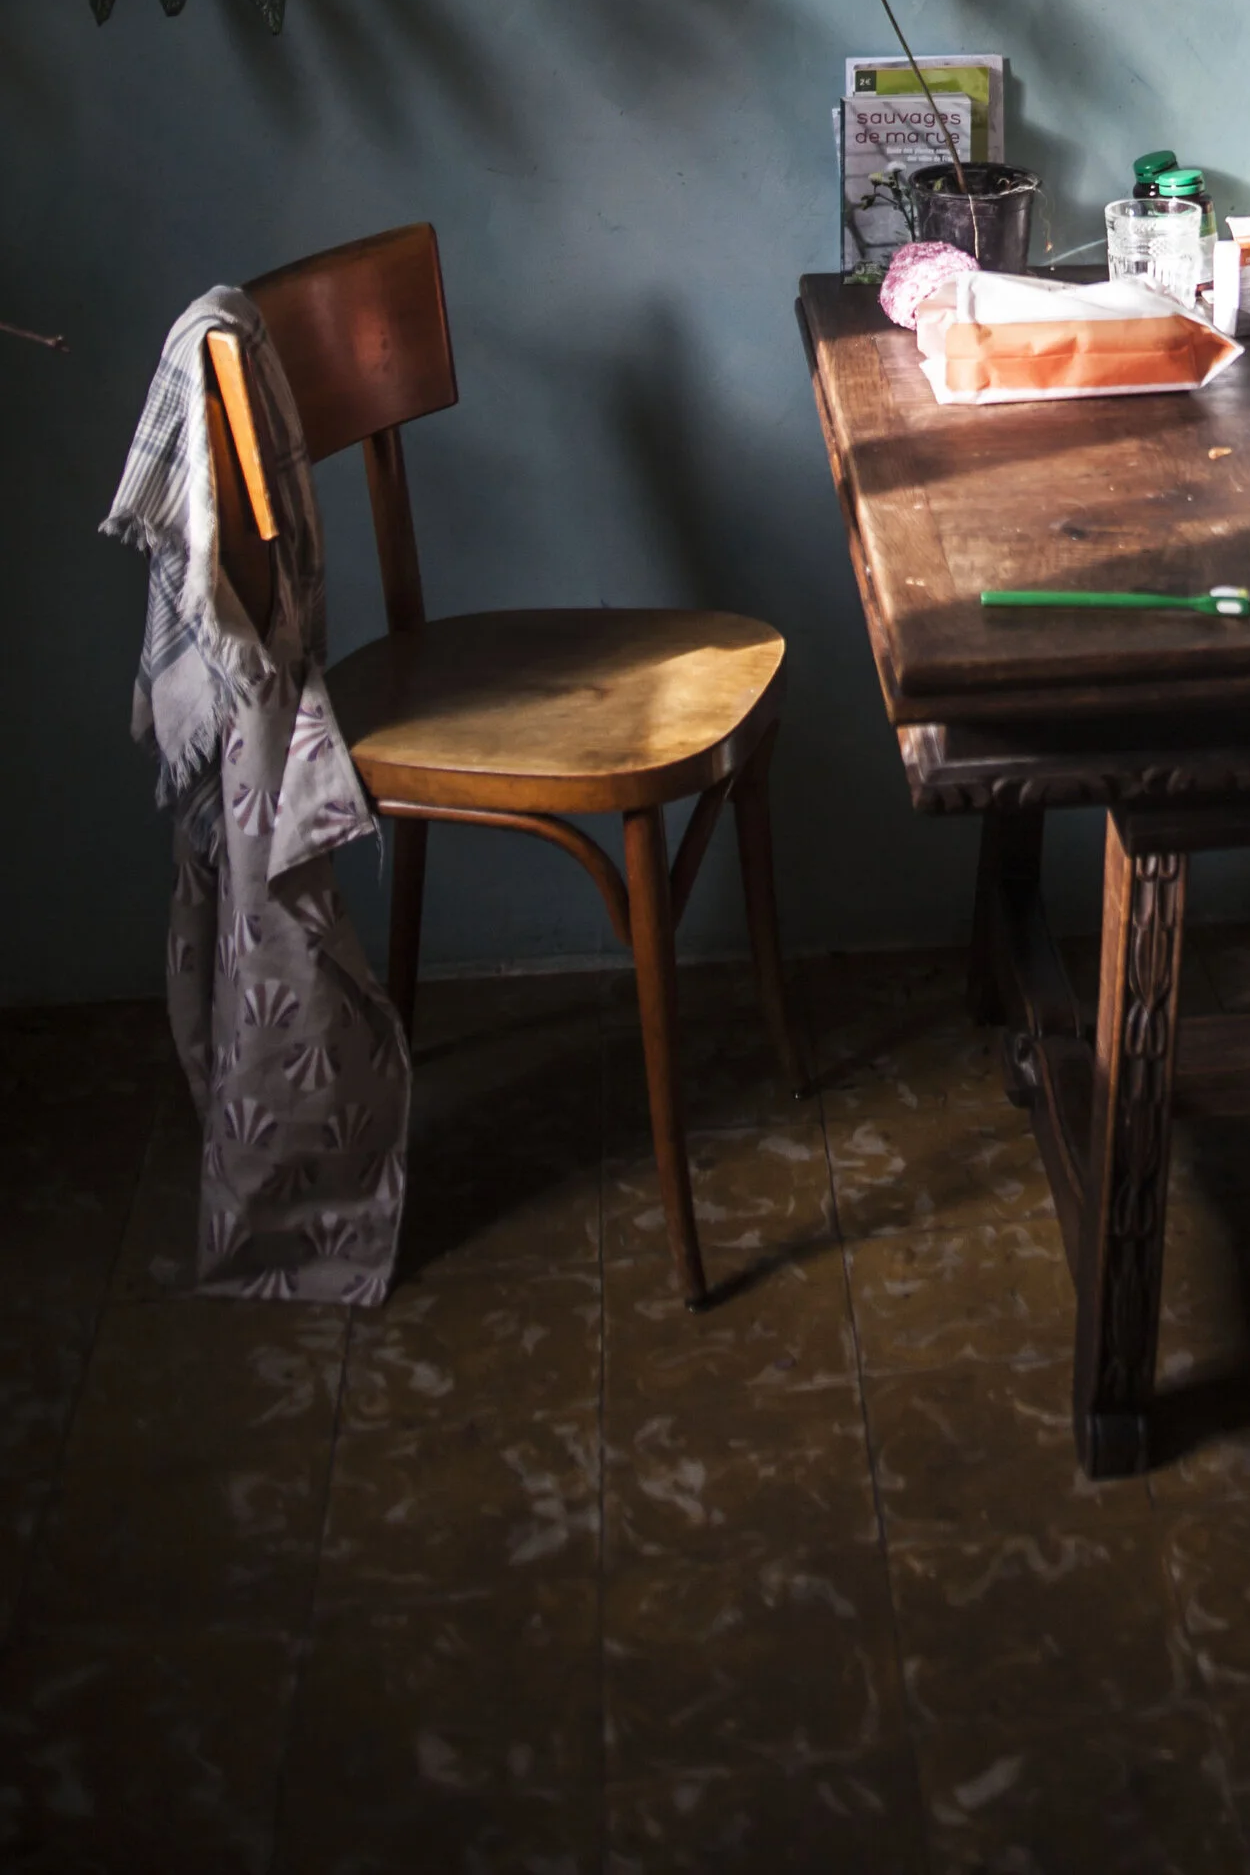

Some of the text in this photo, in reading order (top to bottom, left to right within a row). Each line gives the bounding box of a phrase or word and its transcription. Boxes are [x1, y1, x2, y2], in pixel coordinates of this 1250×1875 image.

[857, 111, 962, 128] sauvages
[855, 129, 960, 144] de ma rue
